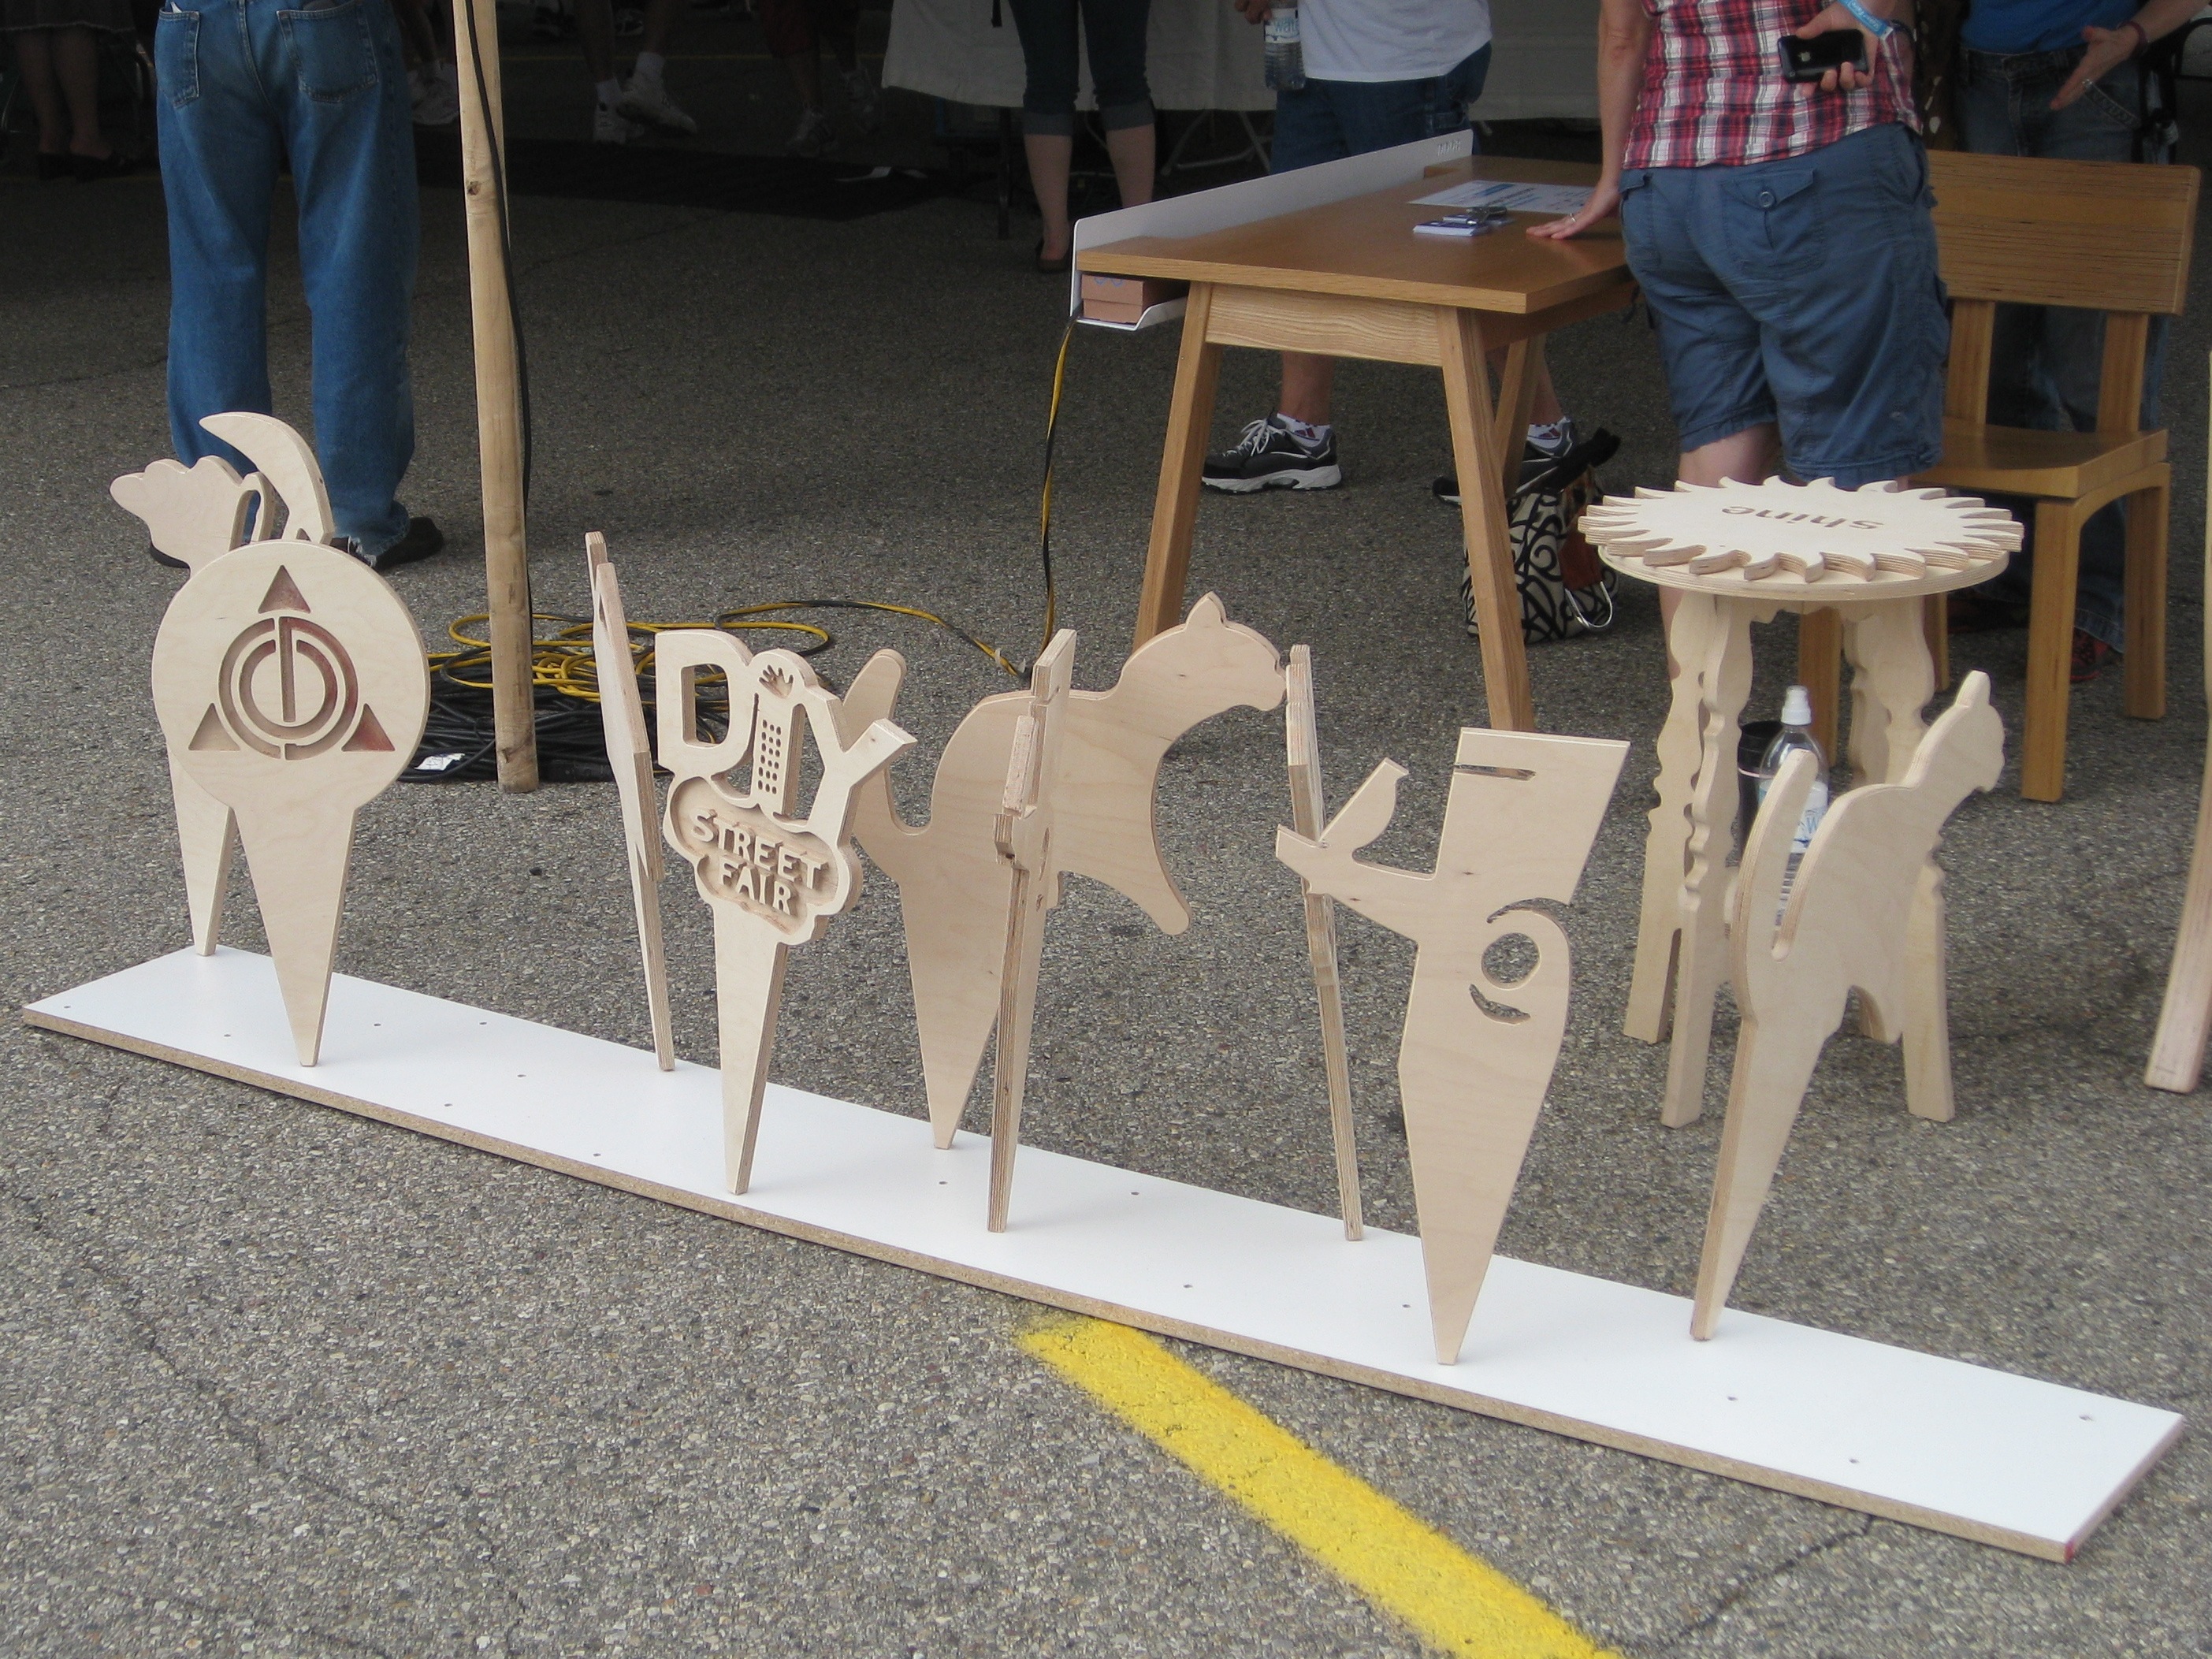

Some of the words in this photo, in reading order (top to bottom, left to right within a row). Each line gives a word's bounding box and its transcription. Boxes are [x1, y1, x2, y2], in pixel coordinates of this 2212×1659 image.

[1721, 506, 1884, 530] shine
[655, 629, 917, 828] DIY
[690, 808, 828, 889] STREET
[719, 854, 792, 916] FAIR
